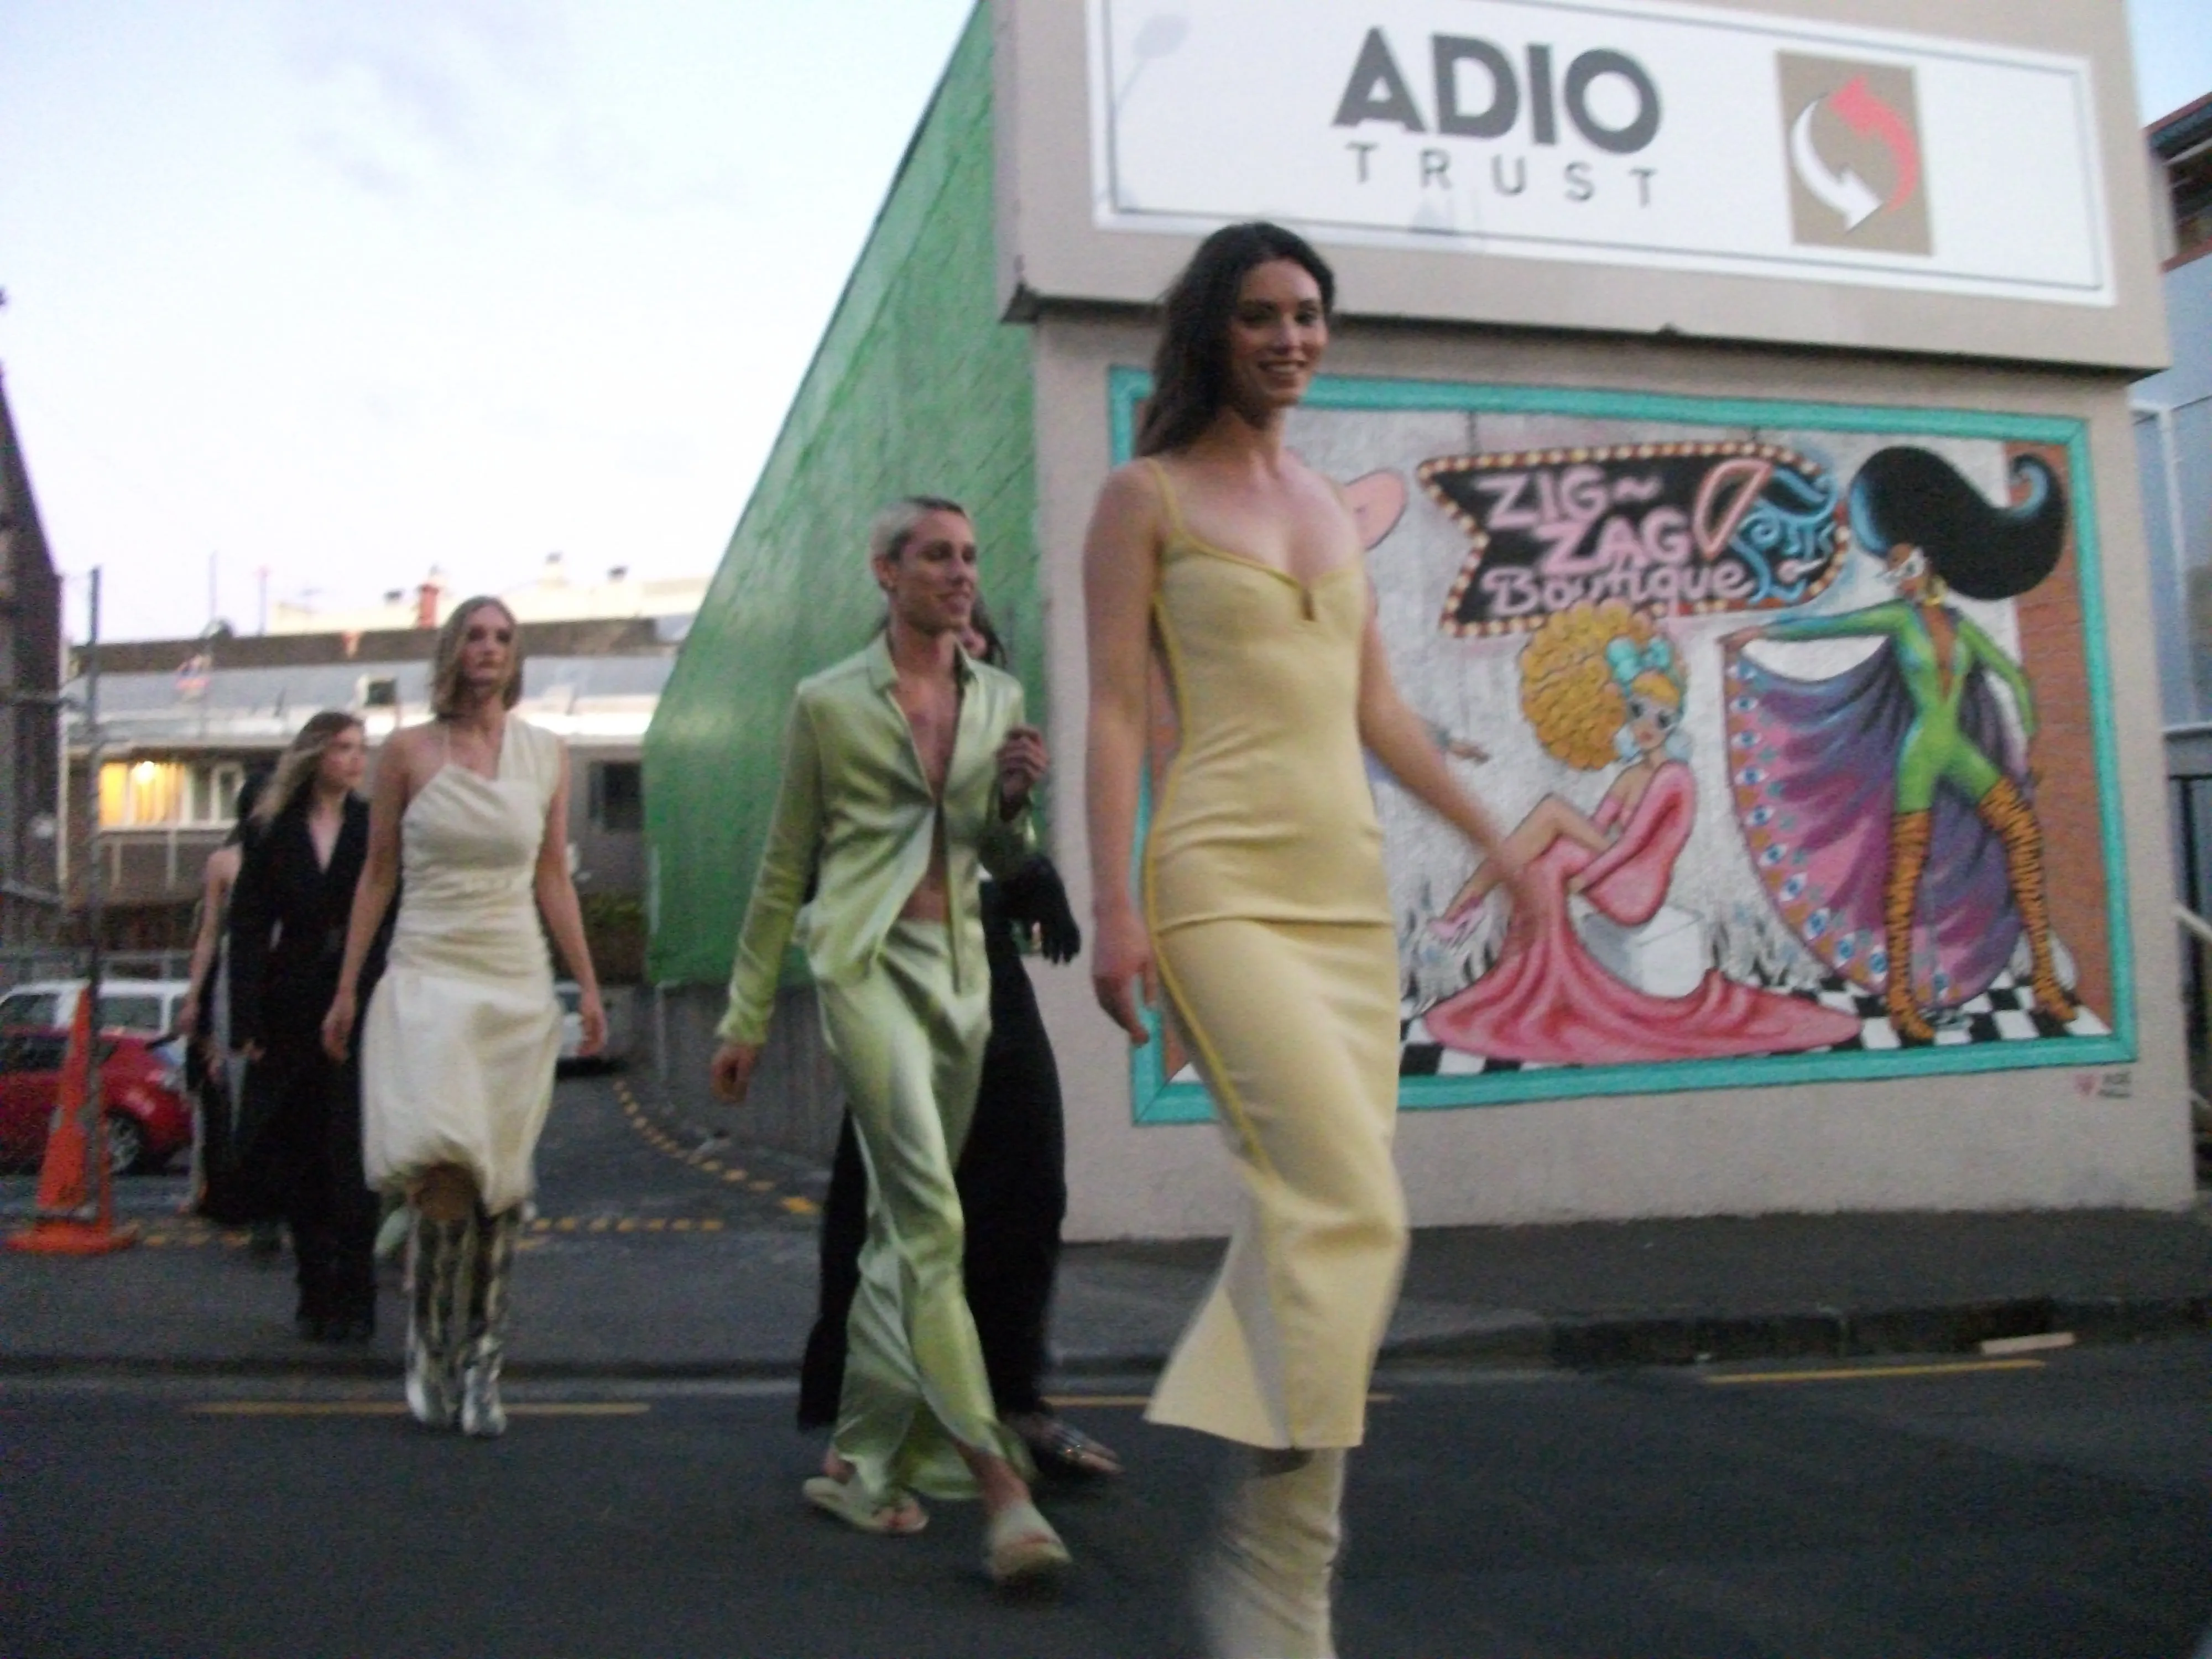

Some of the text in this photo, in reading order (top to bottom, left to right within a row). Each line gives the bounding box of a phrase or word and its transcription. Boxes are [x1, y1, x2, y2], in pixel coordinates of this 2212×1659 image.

[1333, 26, 1662, 155] ADIO
[1347, 141, 1656, 208] TRUST
[1533, 506, 1693, 575] ZAG
[1480, 555, 1756, 620] Boutique
